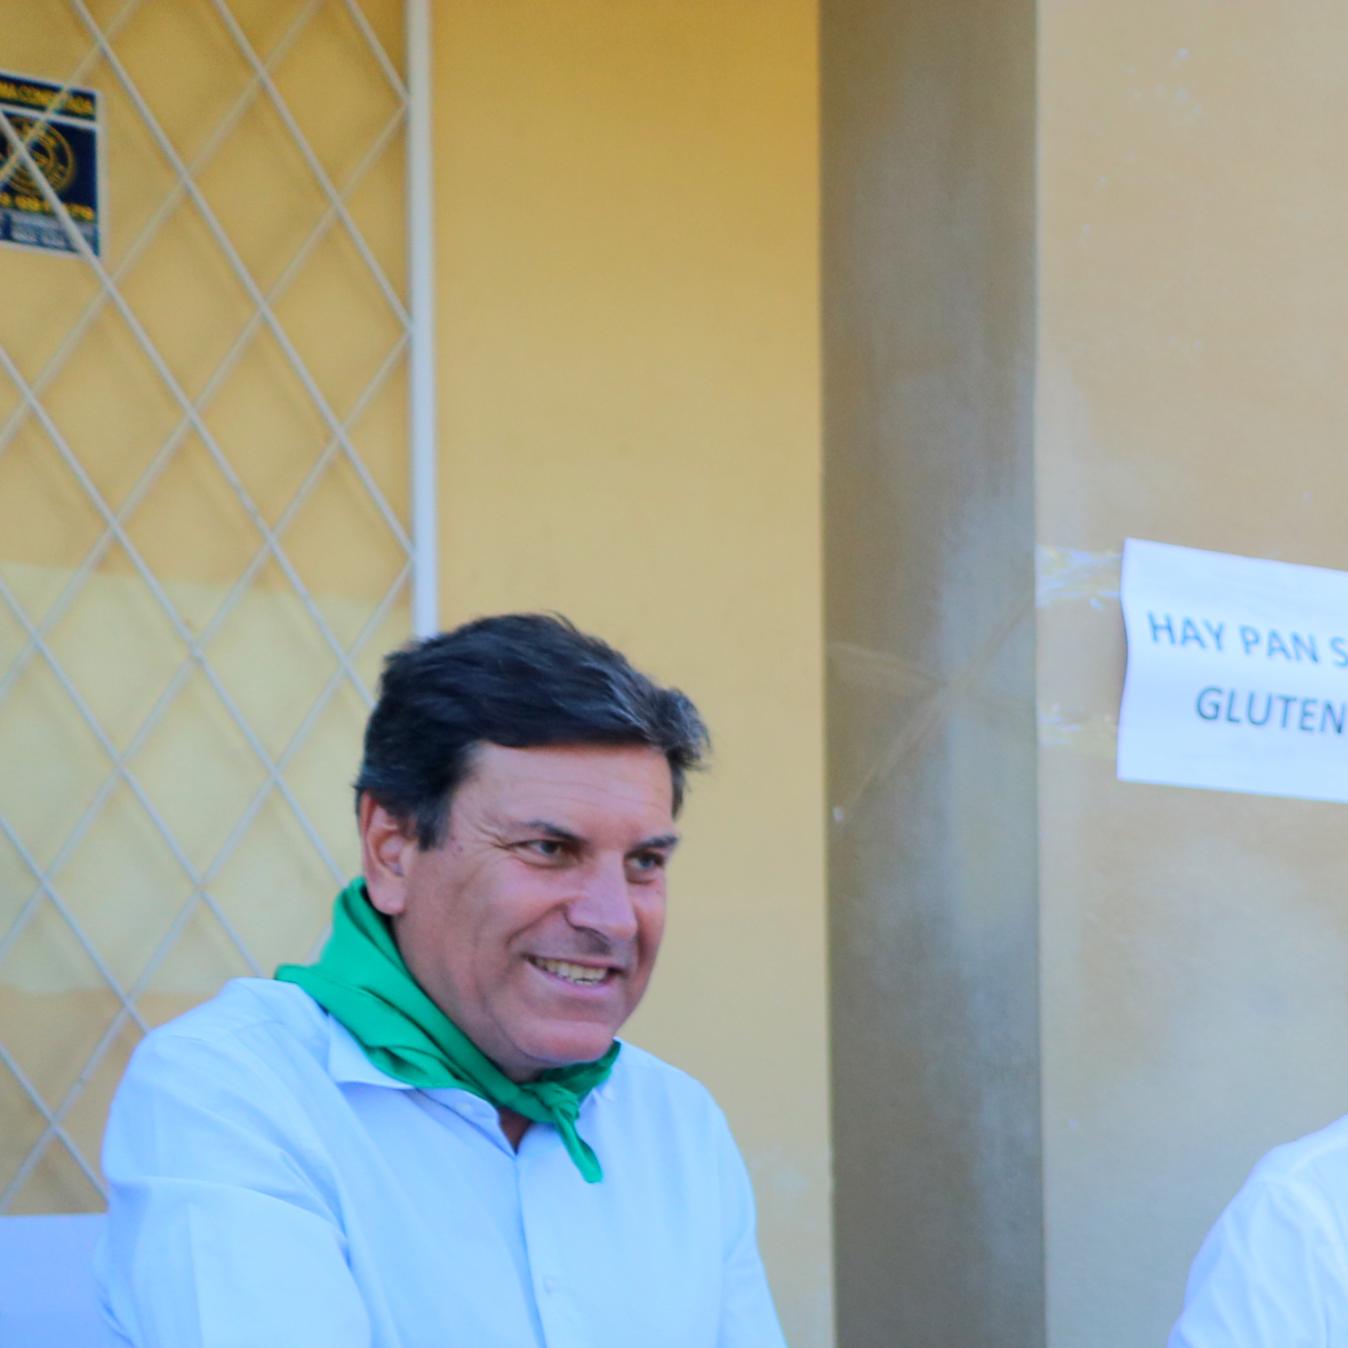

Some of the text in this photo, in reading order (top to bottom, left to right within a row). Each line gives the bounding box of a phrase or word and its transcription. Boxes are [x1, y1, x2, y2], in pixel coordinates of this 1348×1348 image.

[1147, 610, 1225, 651] HAY
[1239, 624, 1320, 664] PAN
[1195, 686, 1347, 735] GLUTEN
